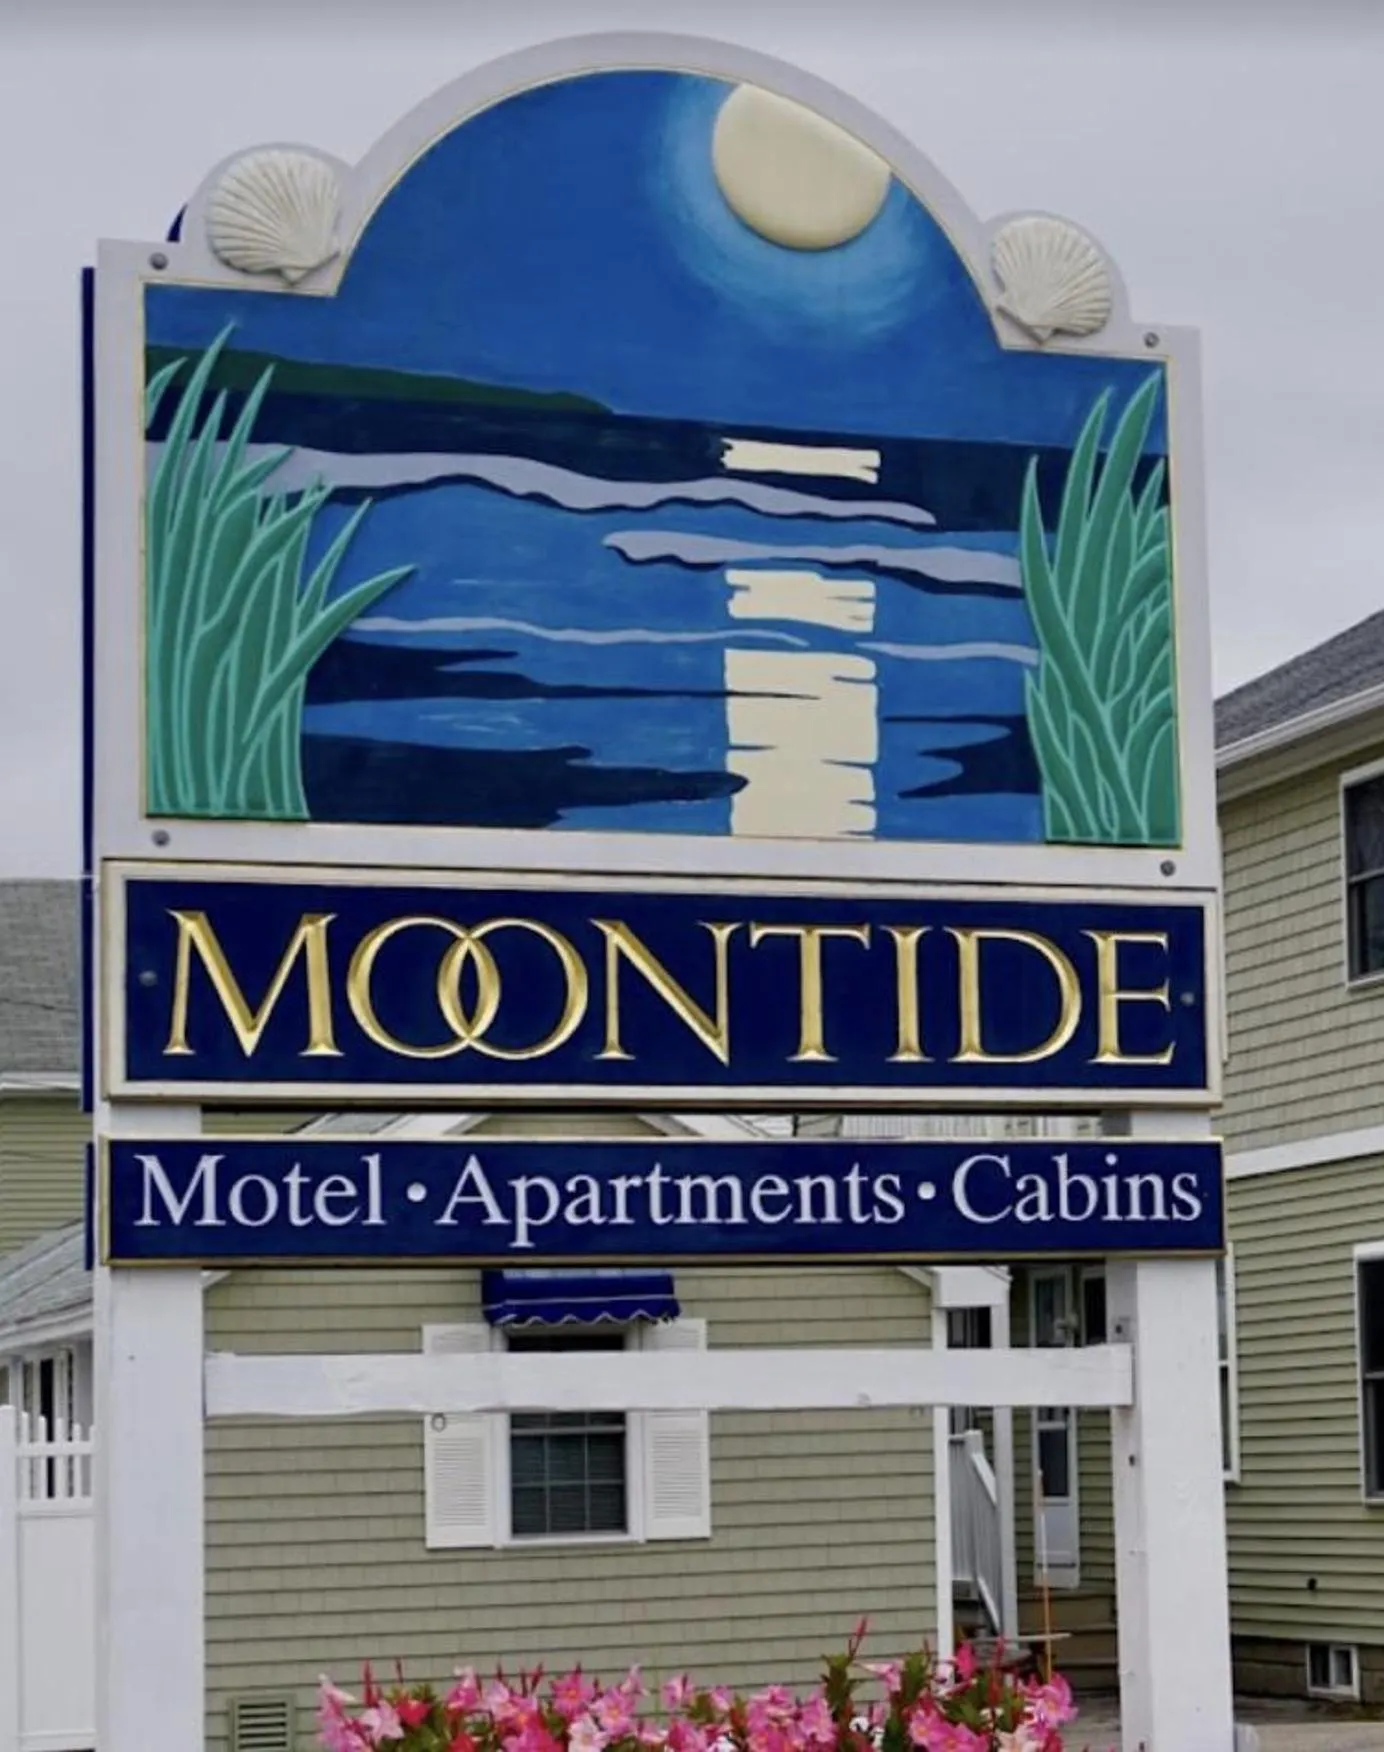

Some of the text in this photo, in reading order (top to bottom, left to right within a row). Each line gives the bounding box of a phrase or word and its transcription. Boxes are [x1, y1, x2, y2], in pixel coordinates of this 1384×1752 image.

[162, 909, 1176, 1065] MOONTIDE
[133, 1153, 1203, 1249] Motel Apartments Cabins
